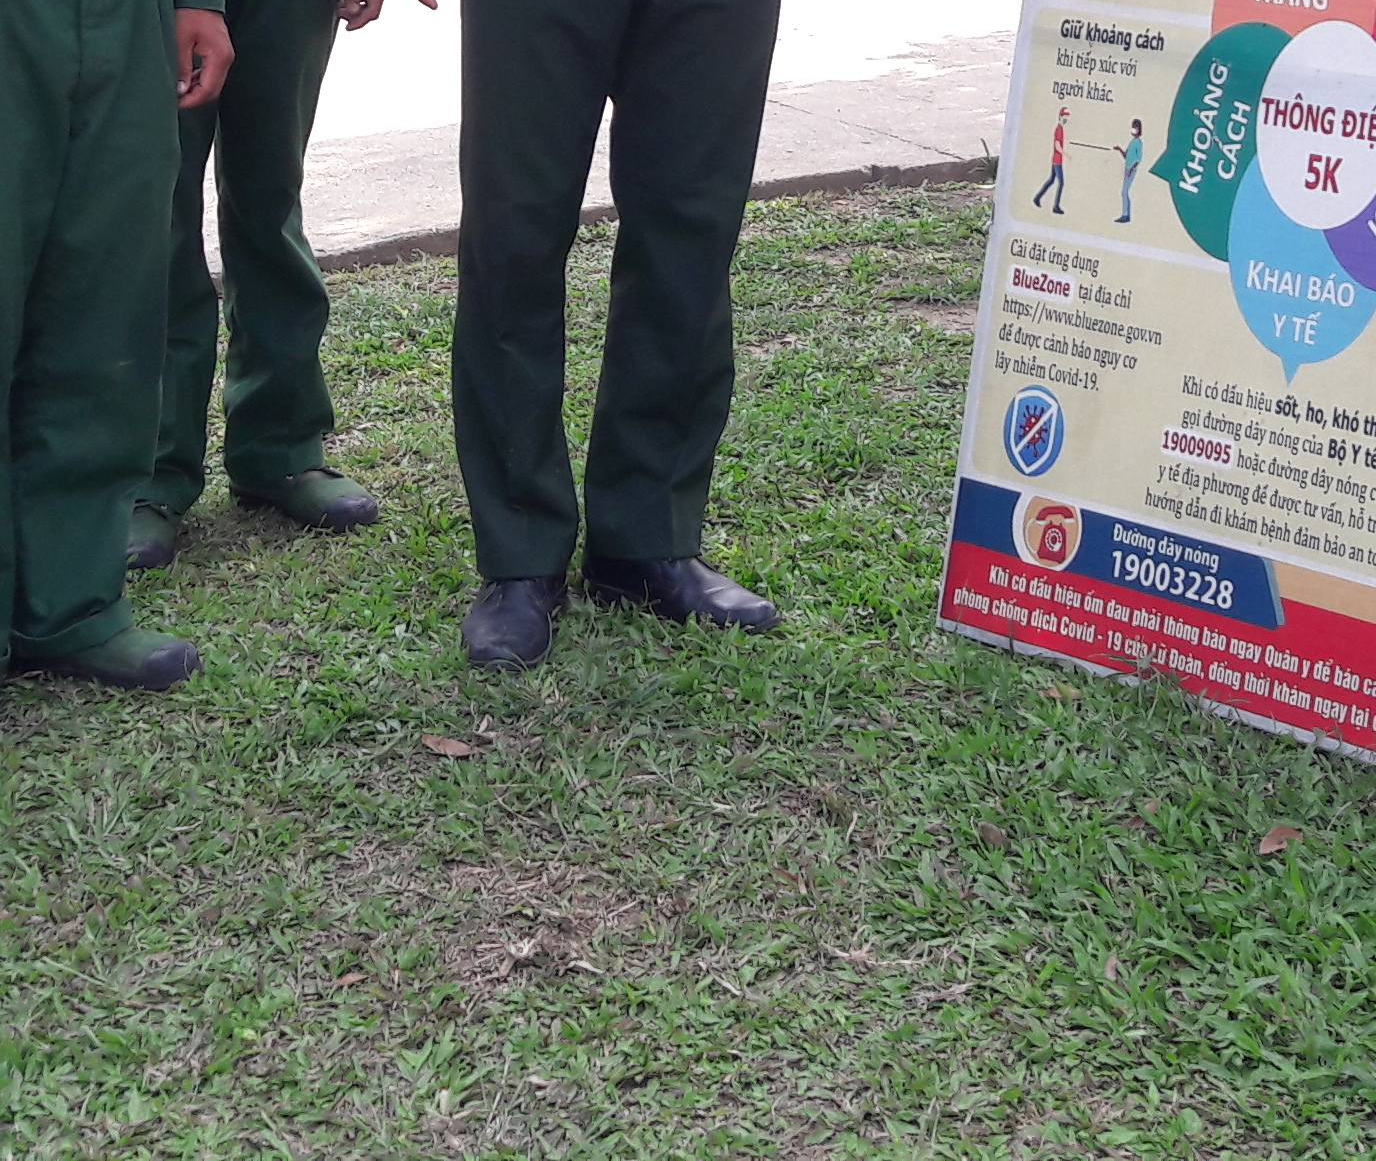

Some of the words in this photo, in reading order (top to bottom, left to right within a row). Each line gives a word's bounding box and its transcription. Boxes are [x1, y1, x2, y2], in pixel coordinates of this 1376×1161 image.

[1061, 19, 1083, 40] Giữ
[1085, 22, 1131, 52] khoảng
[1135, 28, 1163, 52] cách
[1178, 62, 1228, 193] KHOẢNG
[1213, 100, 1251, 179] CÁCH
[1262, 93, 1336, 134] THÔNG
[1304, 154, 1343, 193] 5K
[1010, 239, 1027, 259] Cài
[1029, 243, 1046, 265] đặt
[1049, 246, 1069, 272] ứng
[1072, 251, 1099, 278] dụng
[1246, 259, 1302, 298] KHAI
[1308, 273, 1355, 307] BÁO
[1013, 268, 1069, 298] BlueZone
[1079, 284, 1092, 304] tại
[1095, 285, 1111, 308] địa
[1114, 289, 1131, 309] chỉ
[1003, 294, 1161, 346] https://www.bluezone.gov.vn
[1274, 313, 1286, 337] Y
[1292, 312, 1322, 345] TẾ
[1182, 375, 1201, 397] Khi
[1205, 381, 1218, 400] có
[1221, 384, 1242, 406] dấu
[1246, 389, 1272, 415] hiệu
[1275, 395, 1300, 424] sốt,
[1306, 401, 1326, 430] ho,
[1332, 407, 1358, 433] khó
[1181, 409, 1200, 430] gọi
[1203, 410, 1241, 442] đường
[1245, 420, 1266, 447] dây
[1269, 428, 1299, 456] nóng
[1302, 434, 1322, 456] của
[1328, 439, 1346, 466] Bộ
[1352, 444, 1361, 465] Y
[1163, 430, 1231, 464] 19009095
[1237, 448, 1265, 476] hoặc
[1268, 457, 1308, 490] đường
[1311, 467, 1333, 495] dây
[1336, 475, 1367, 504] nóng
[1114, 523, 1155, 556] Đường
[1158, 536, 1182, 562] dây
[1184, 546, 1218, 573] nóng
[1113, 551, 1233, 609] 19003228
[989, 565, 1008, 588] Khi
[1012, 573, 1026, 593] có
[1029, 576, 1051, 600] dấu
[1054, 584, 1081, 610] hiệu
[1084, 591, 1103, 615] ốm
[1107, 599, 1129, 622] đau
[1132, 608, 1160, 632] phải
[1163, 616, 1199, 645] thông
[1202, 626, 1226, 651] báo
[1230, 639, 1261, 664] ngay
[1265, 645, 1298, 673] Quân
[1302, 660, 1309, 678] y
[1313, 659, 1332, 682] để
[1333, 666, 1359, 691] báo
